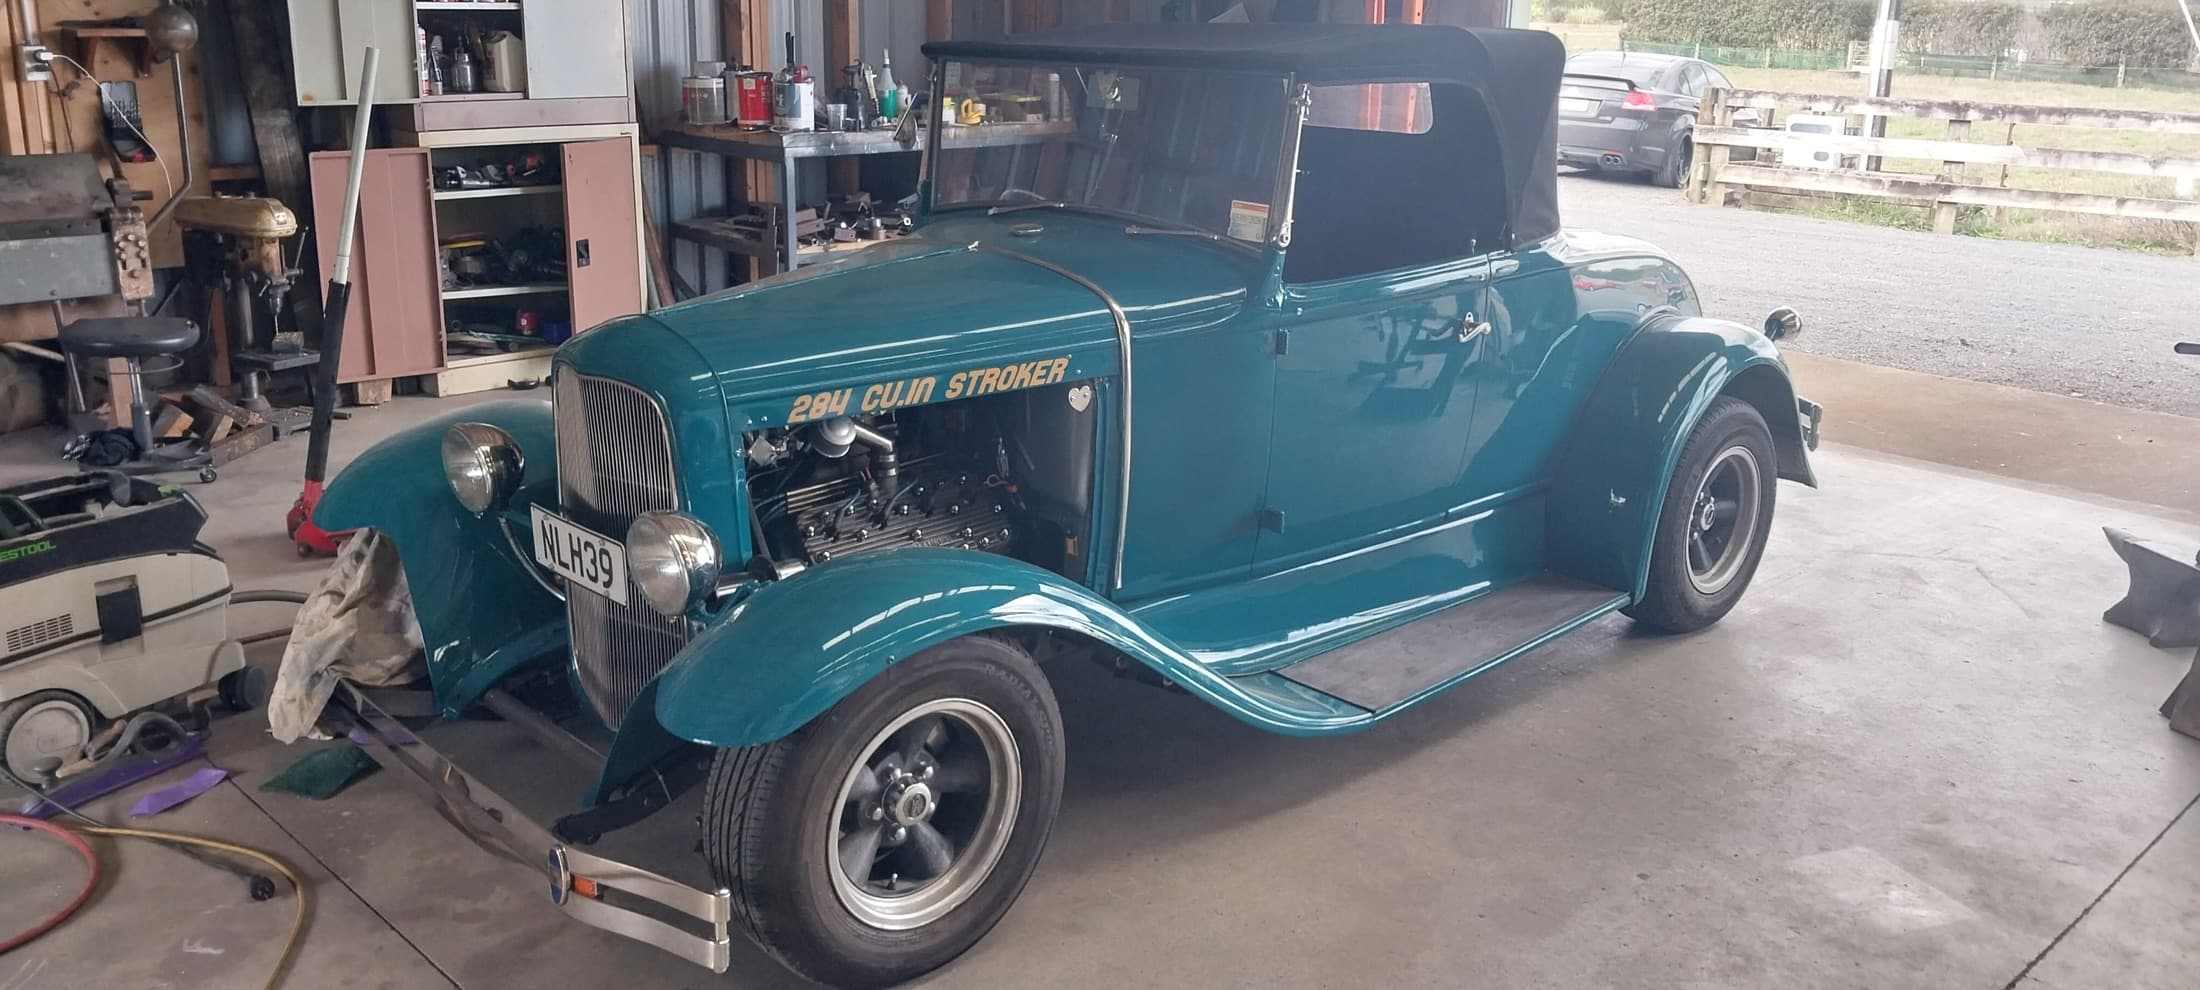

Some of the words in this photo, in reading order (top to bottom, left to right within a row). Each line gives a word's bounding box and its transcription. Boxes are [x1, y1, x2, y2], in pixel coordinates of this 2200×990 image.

[787, 389, 852, 424] 284
[861, 376, 936, 412] CU.IN
[945, 357, 1070, 399] STROKER
[541, 519, 614, 589] NLH39
